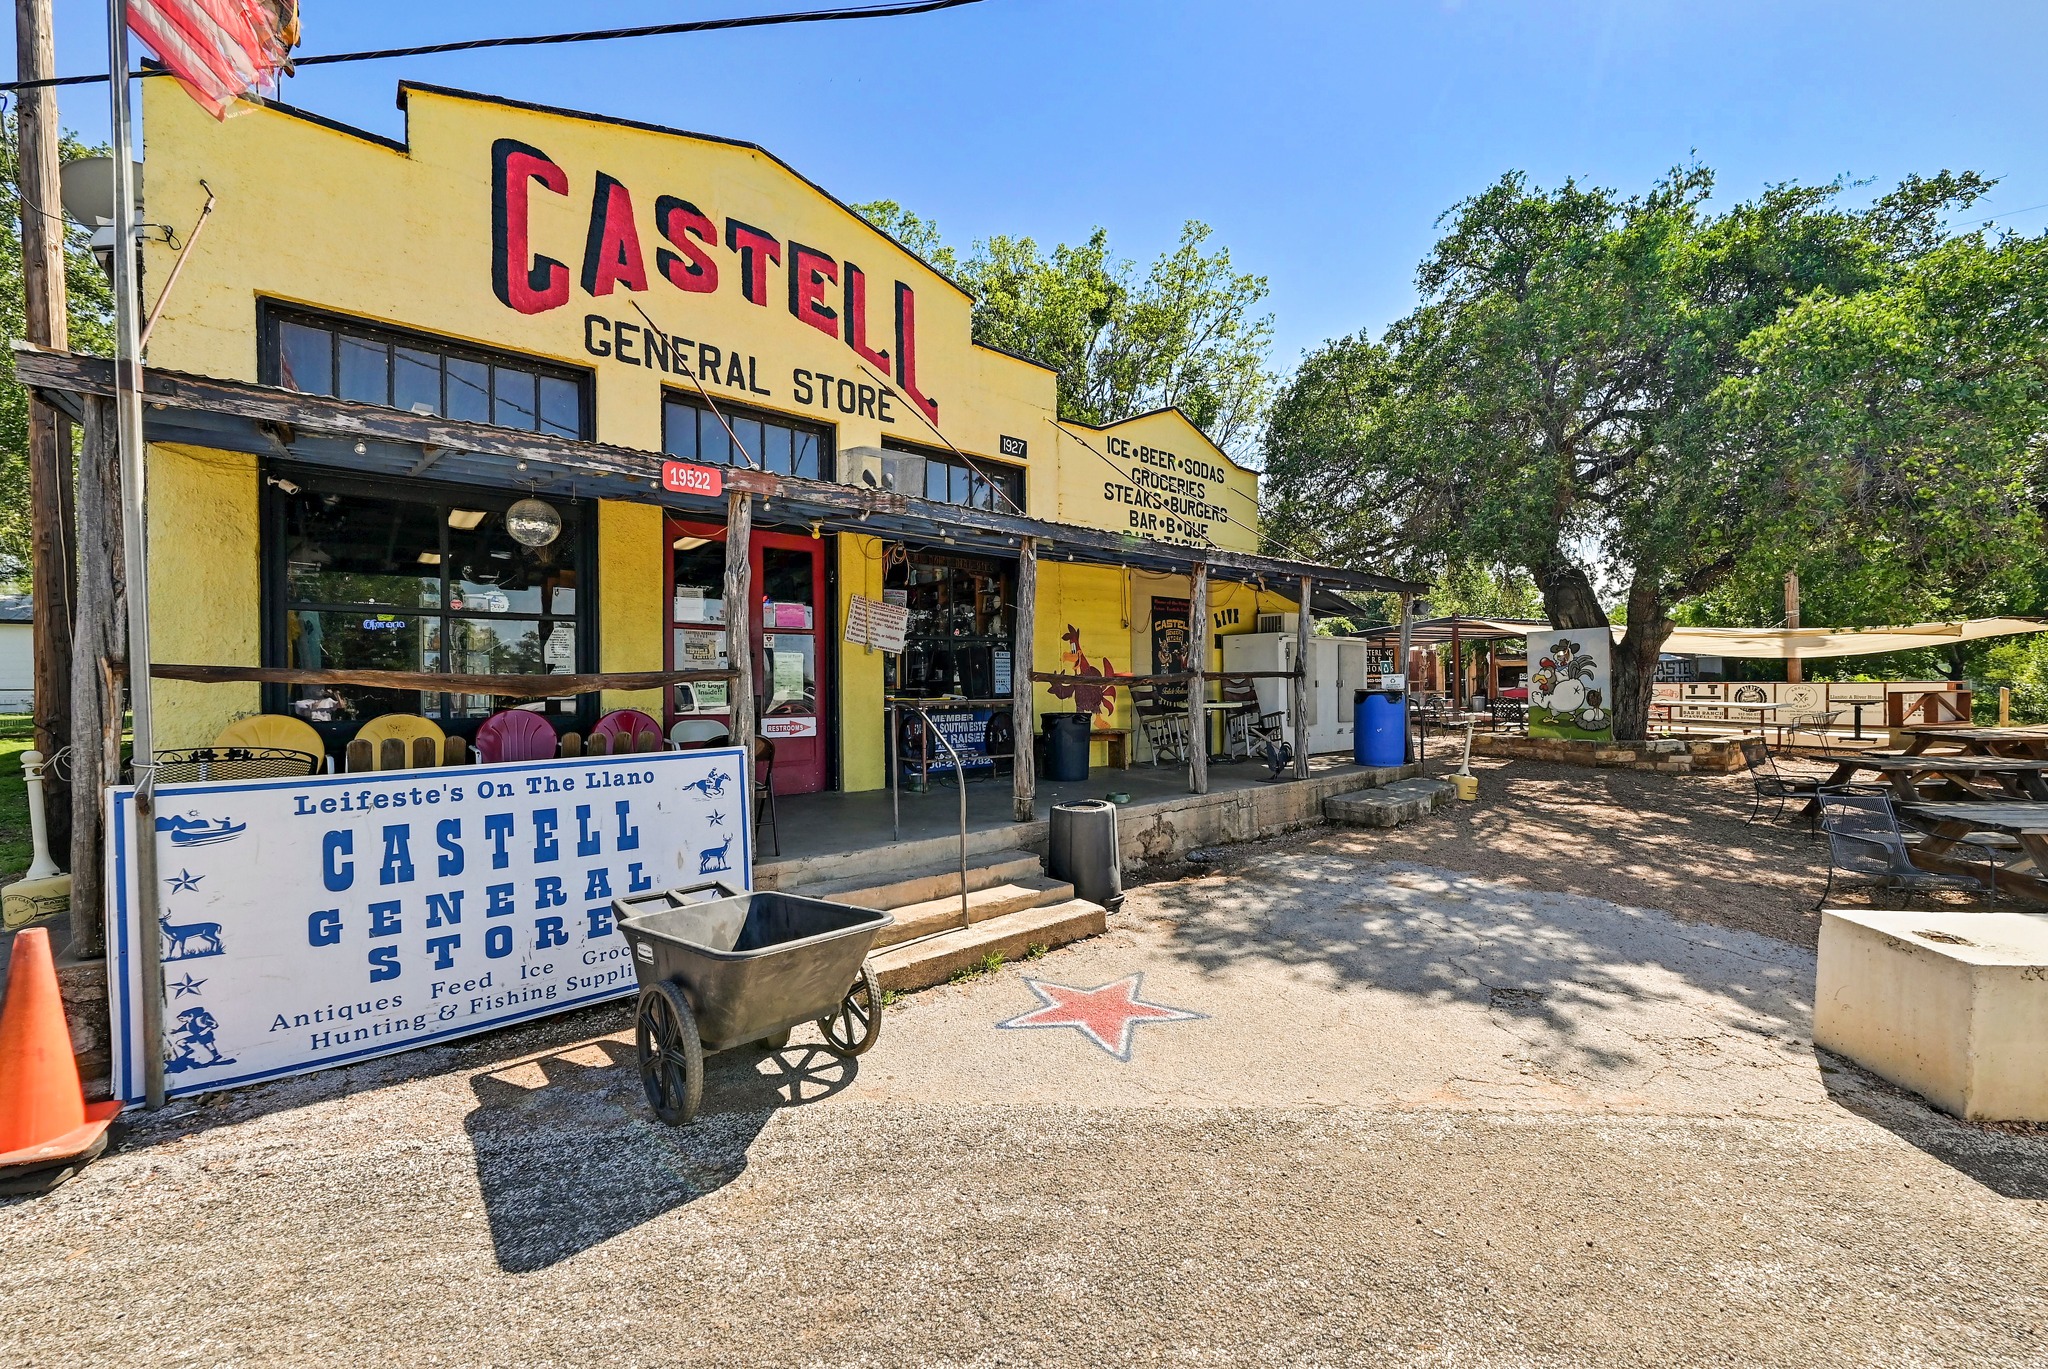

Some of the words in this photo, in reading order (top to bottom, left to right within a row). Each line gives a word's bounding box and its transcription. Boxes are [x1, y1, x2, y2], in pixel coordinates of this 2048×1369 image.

[491, 138, 939, 428] CASTELL
[584, 314, 771, 397] GENERAL
[793, 367, 895, 424] STORE
[1003, 438, 1025, 455] 1927
[1107, 435, 1131, 459] ICE
[1140, 445, 1176, 472] BEER
[1184, 458, 1225, 484] SODAS
[670, 467, 711, 490] 19522
[1131, 467, 1206, 500] GROCERIES
[1104, 482, 1162, 510] STEAKS
[1170, 496, 1228, 523] BURGERS
[1129, 509, 1157, 531] BAR
[1166, 516, 1175, 534] B
[1184, 520, 1209, 540] QUE
[1154, 619, 1190, 632] CASTEL
[1213, 608, 1239, 629] LIVE
[768, 724, 804, 732] RESTROOMS
[932, 714, 974, 722] MEMBER
[940, 720, 988, 734] SOUTHWESTE
[294, 784, 465, 816] Leifeste's
[477, 780, 515, 800] On
[526, 775, 576, 797] The
[584, 770, 656, 790] Llano
[322, 800, 640, 893] CASTELL
[307, 861, 653, 948] GENERAL
[367, 905, 614, 984] STORE
[269, 994, 404, 1033] Antiques
[430, 972, 493, 1001] Feed
[520, 962, 555, 981] Ice
[310, 1011, 428, 1052] Hunting
[437, 1004, 458, 1022] &
[469, 982, 558, 1016] Fishing
[565, 962, 634, 993] Suppli
